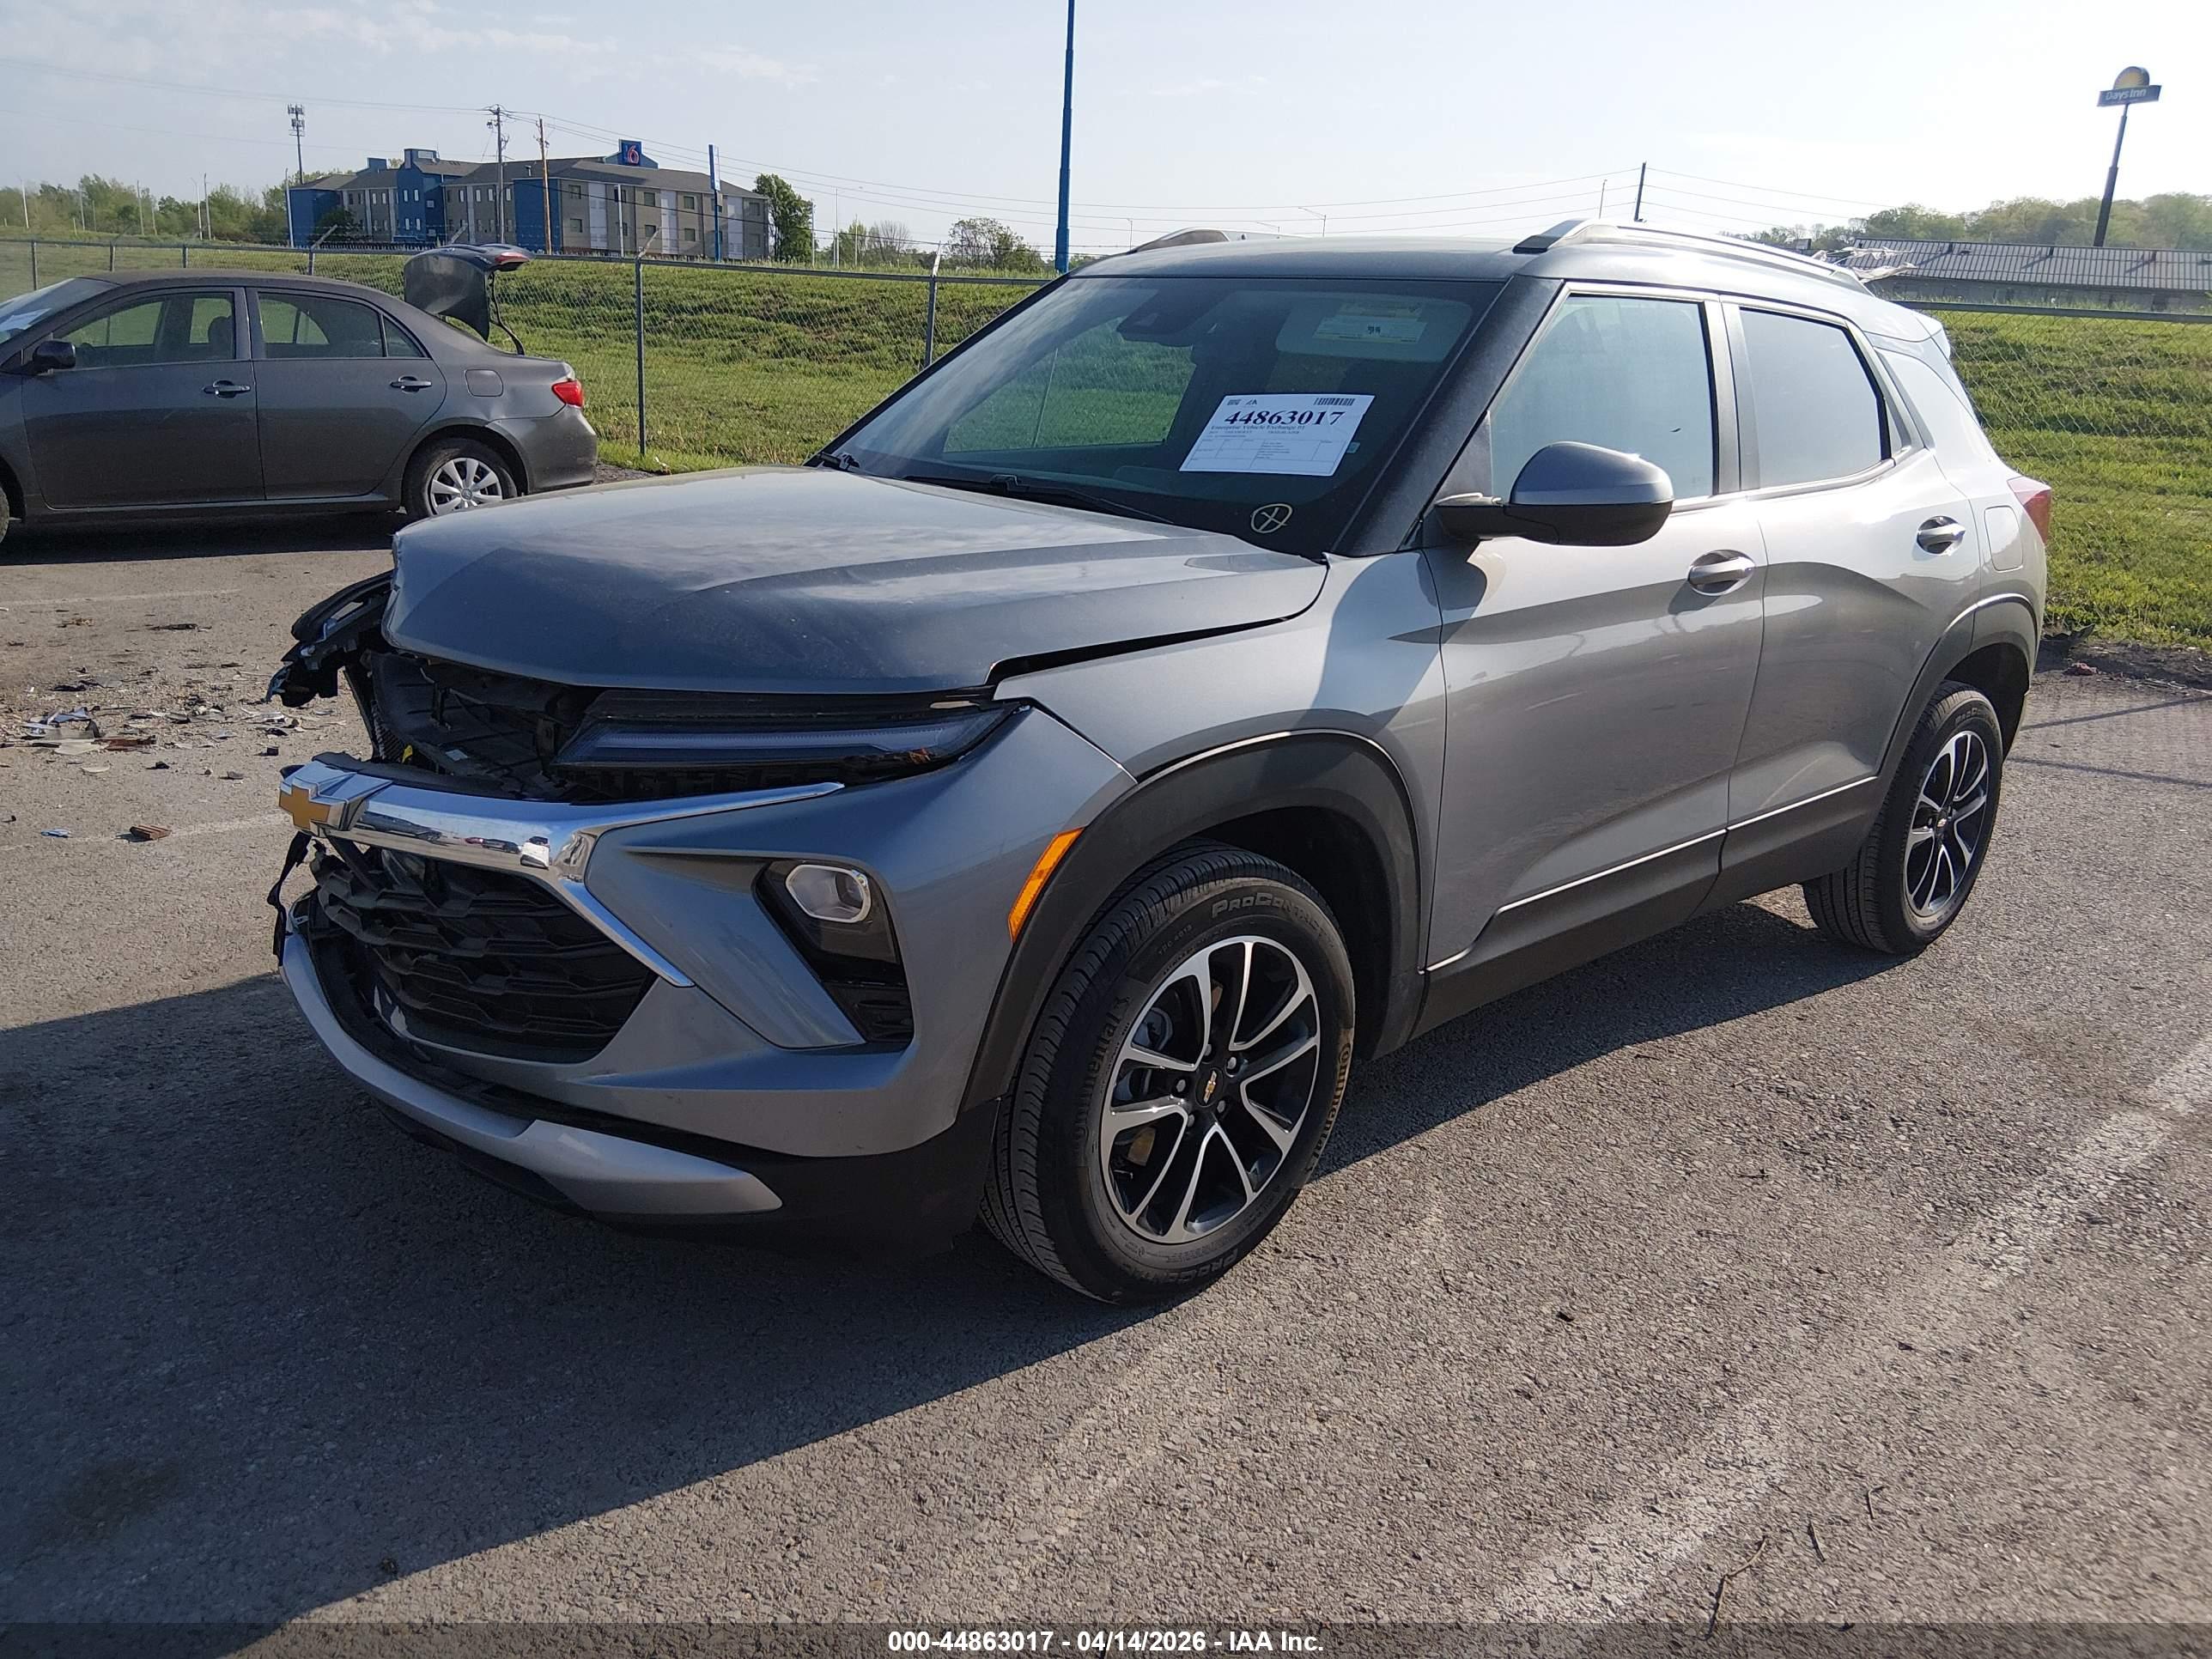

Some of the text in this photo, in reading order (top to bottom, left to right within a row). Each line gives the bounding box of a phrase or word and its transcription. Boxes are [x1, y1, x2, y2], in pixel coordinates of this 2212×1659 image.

[2106, 88, 2147, 100] Days Inn
[627, 145, 640, 164] 6
[1224, 410, 1346, 425] 44863017
